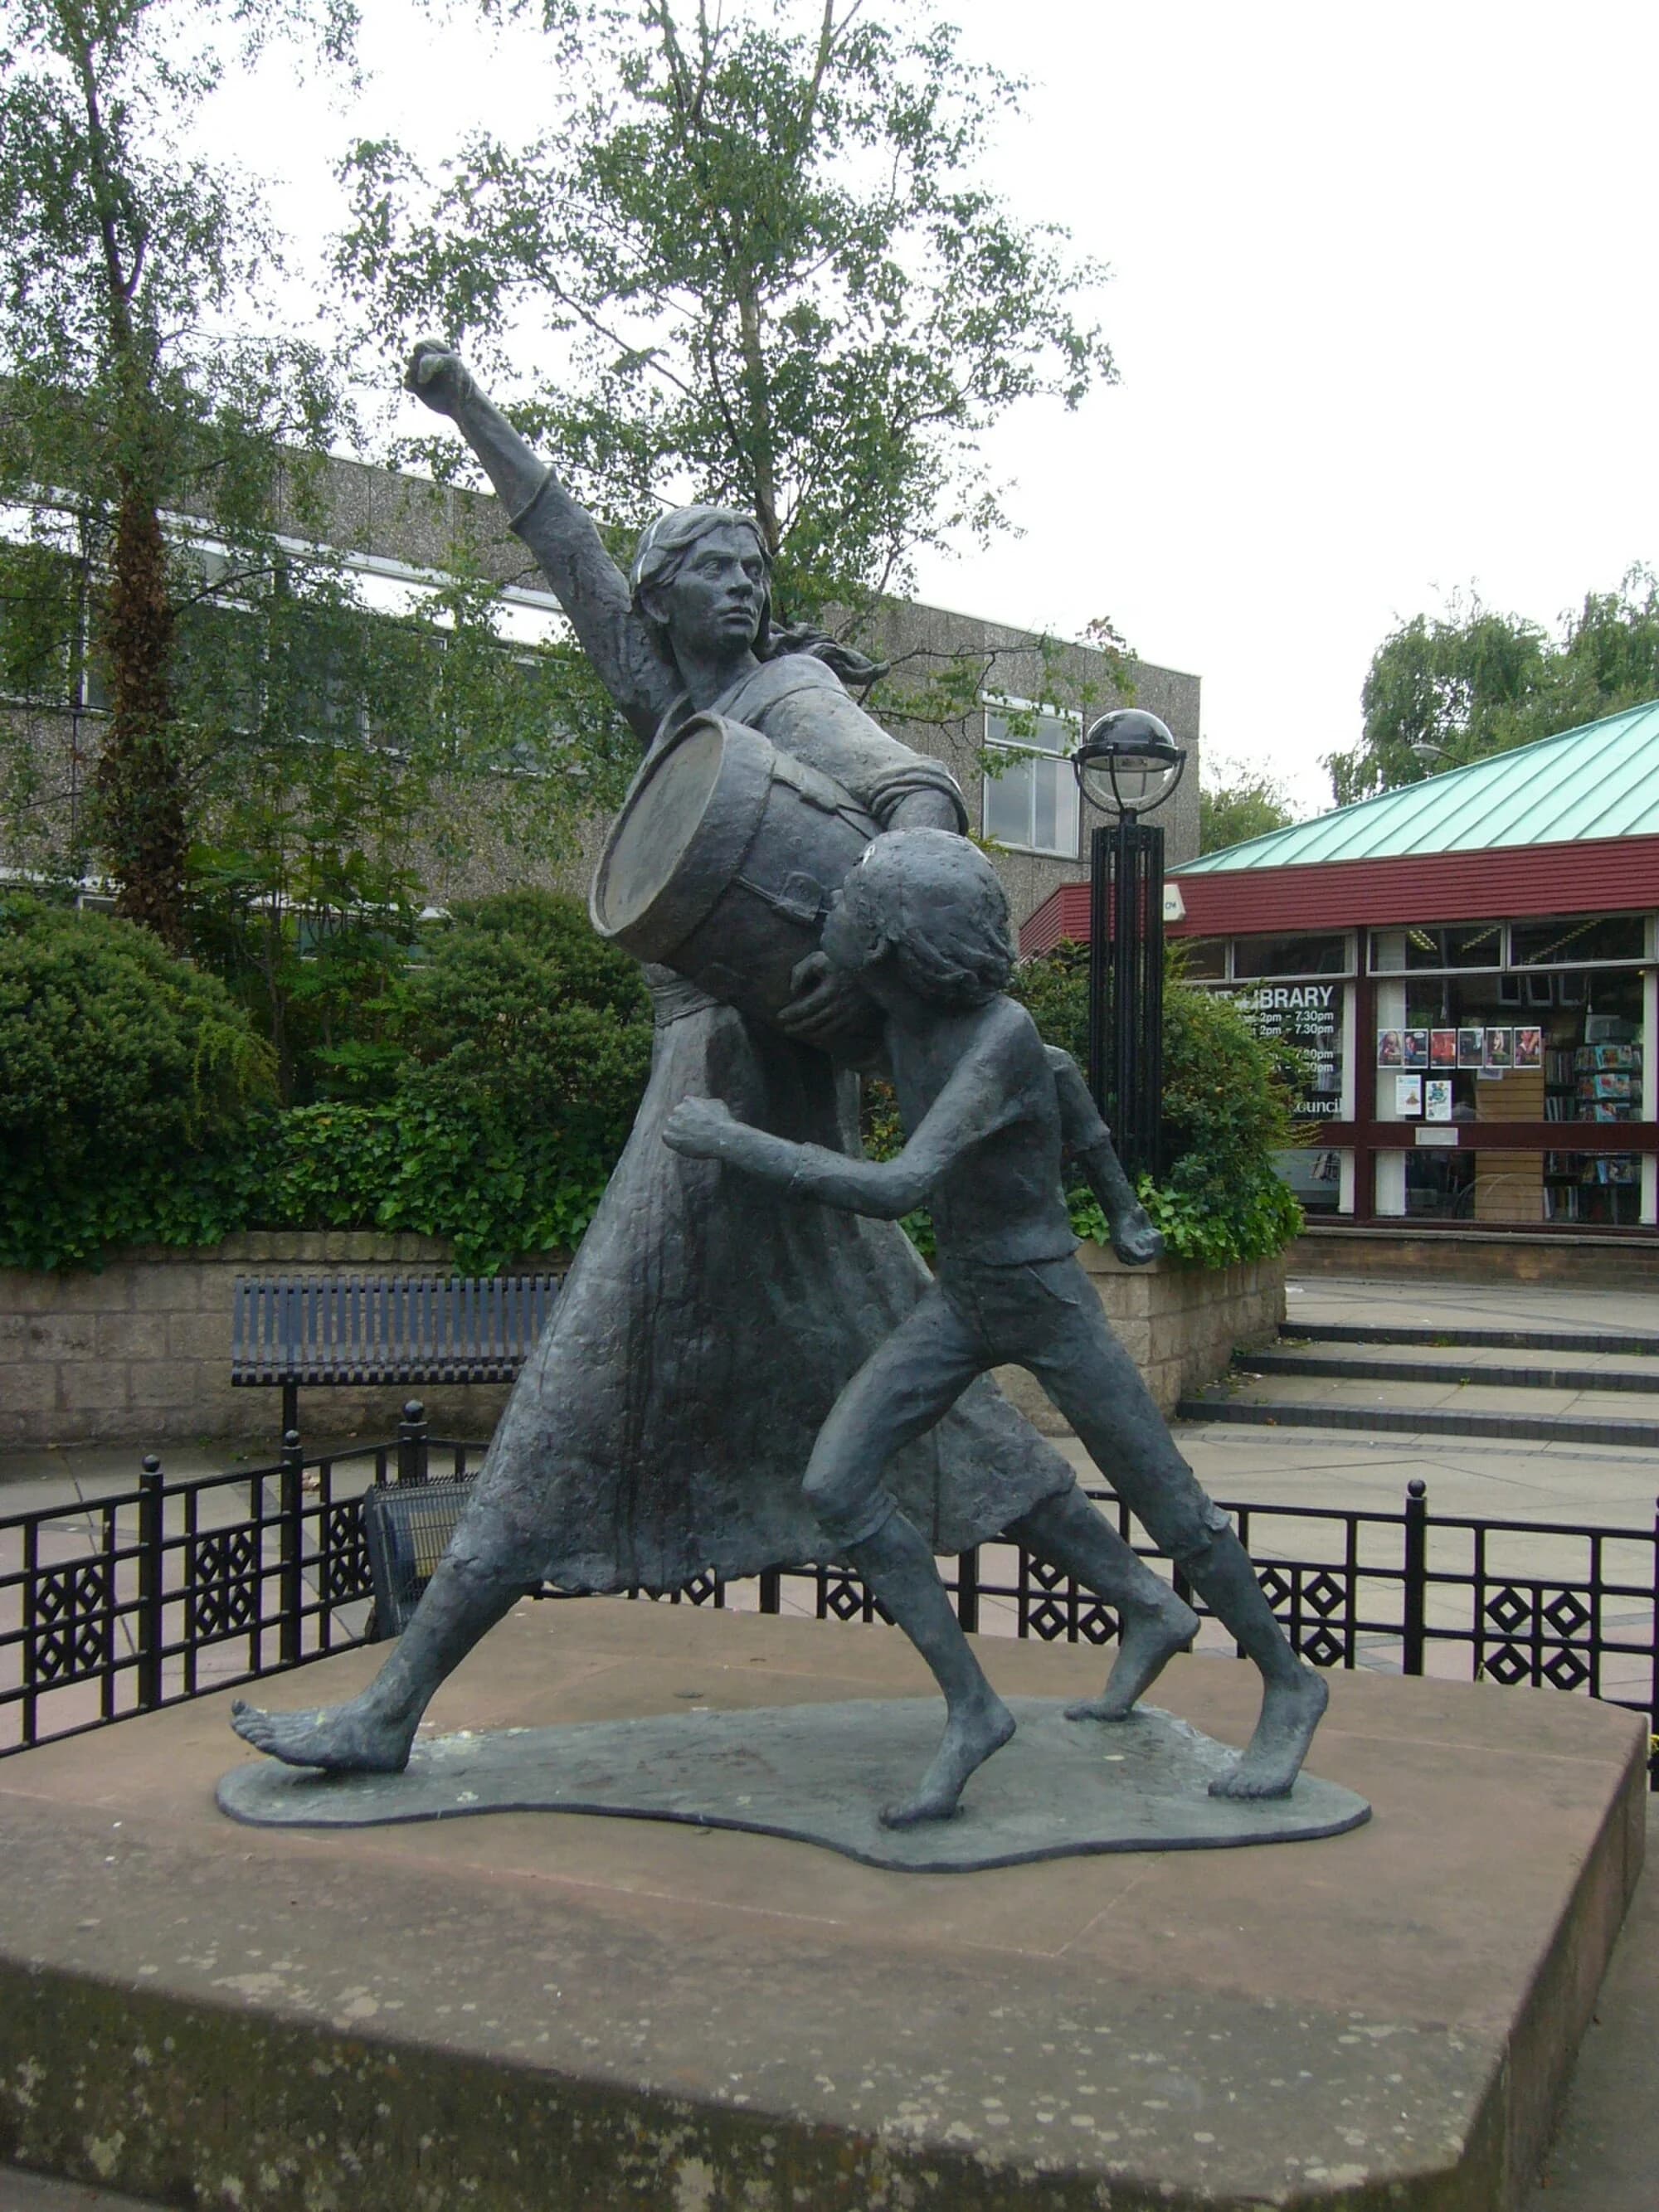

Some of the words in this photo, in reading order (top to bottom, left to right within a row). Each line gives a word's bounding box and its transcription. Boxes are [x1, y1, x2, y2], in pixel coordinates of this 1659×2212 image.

[1260, 1013, 1282, 1023] 2pm
[1295, 1011, 1334, 1022] 7.30pm
[1260, 1025, 1282, 1037] 2pm
[1295, 1024, 1334, 1035] 7.30pm
[1296, 1049, 1334, 1060] 730pm
[1294, 1098, 1342, 1113] ouncil
